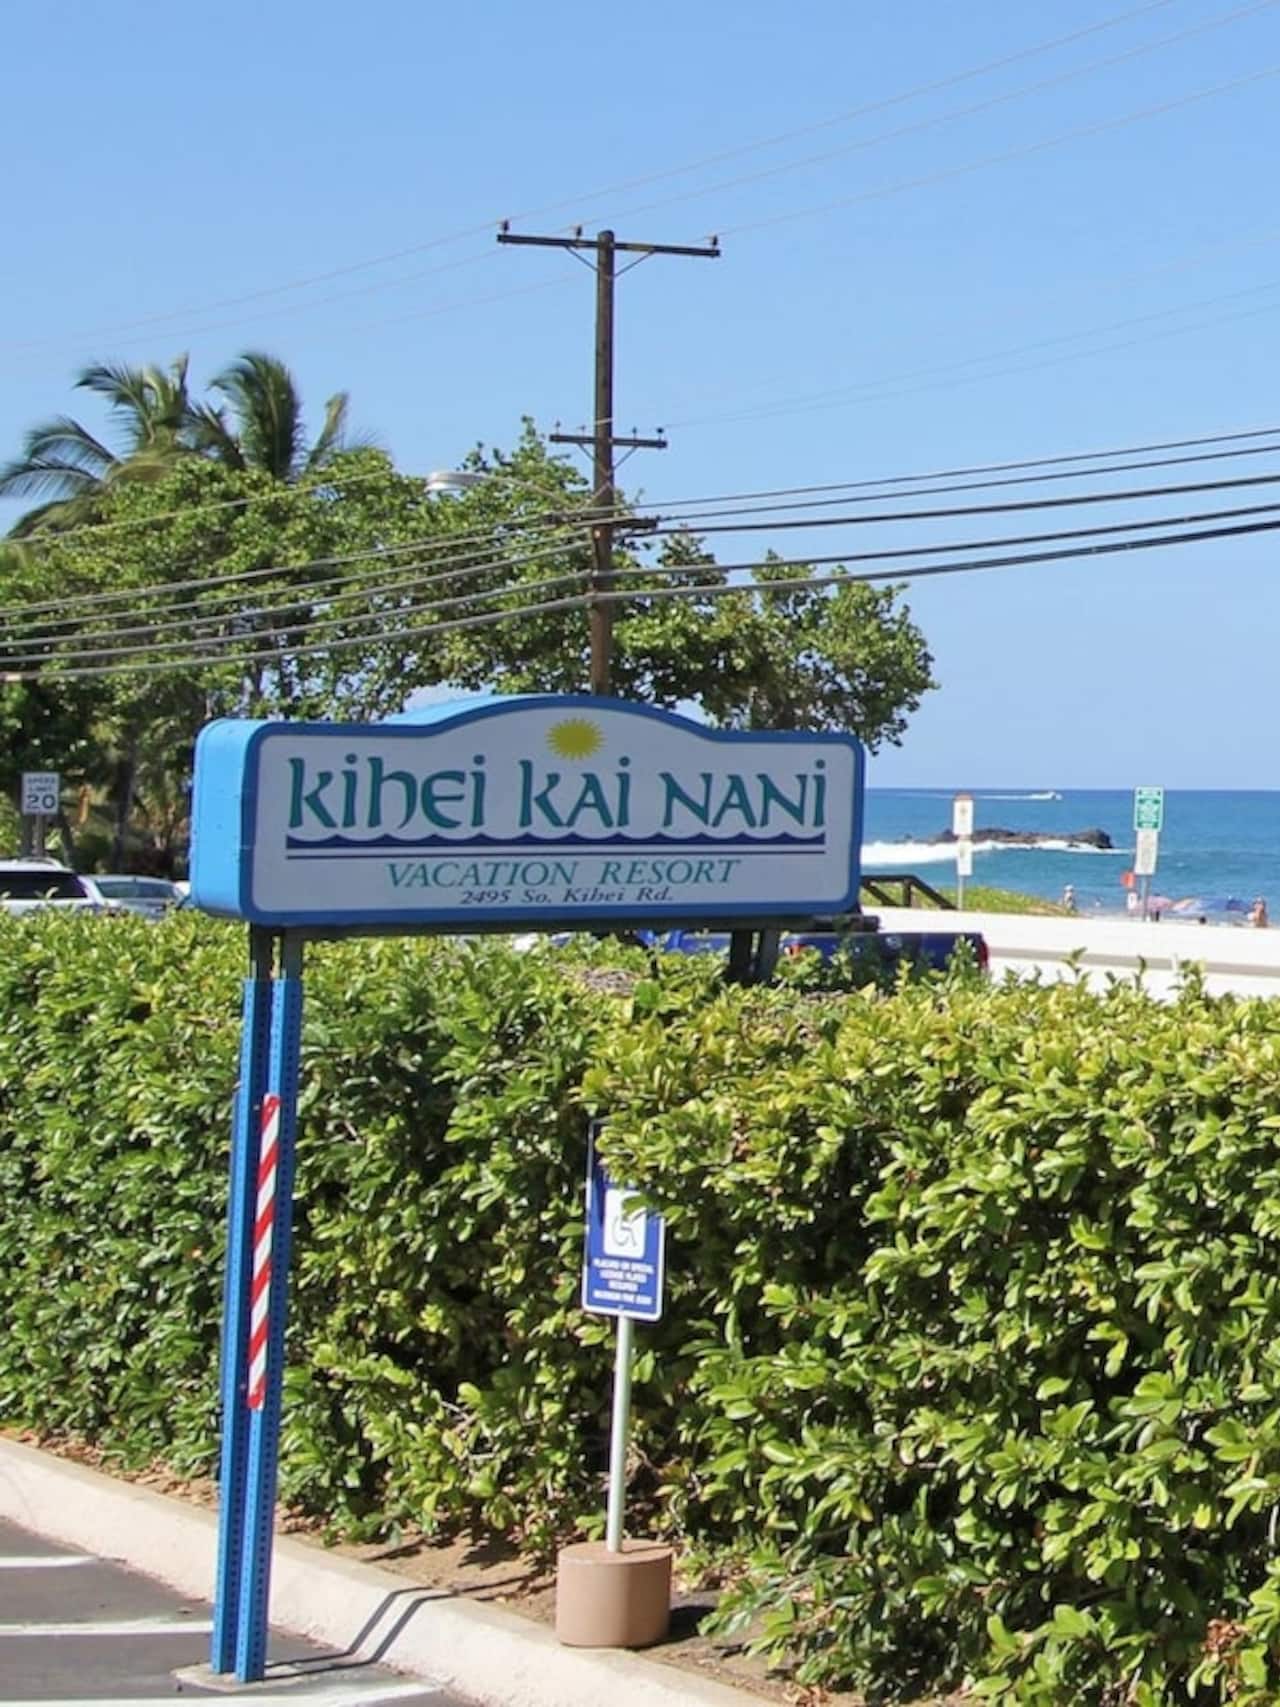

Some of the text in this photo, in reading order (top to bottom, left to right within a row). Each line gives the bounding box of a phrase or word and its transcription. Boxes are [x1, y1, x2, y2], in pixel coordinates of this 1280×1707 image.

[27, 793, 56, 810] 20
[387, 859, 741, 888] VACATION RESORT
[460, 886, 673, 905] 2495 So. Kihei Rd.
